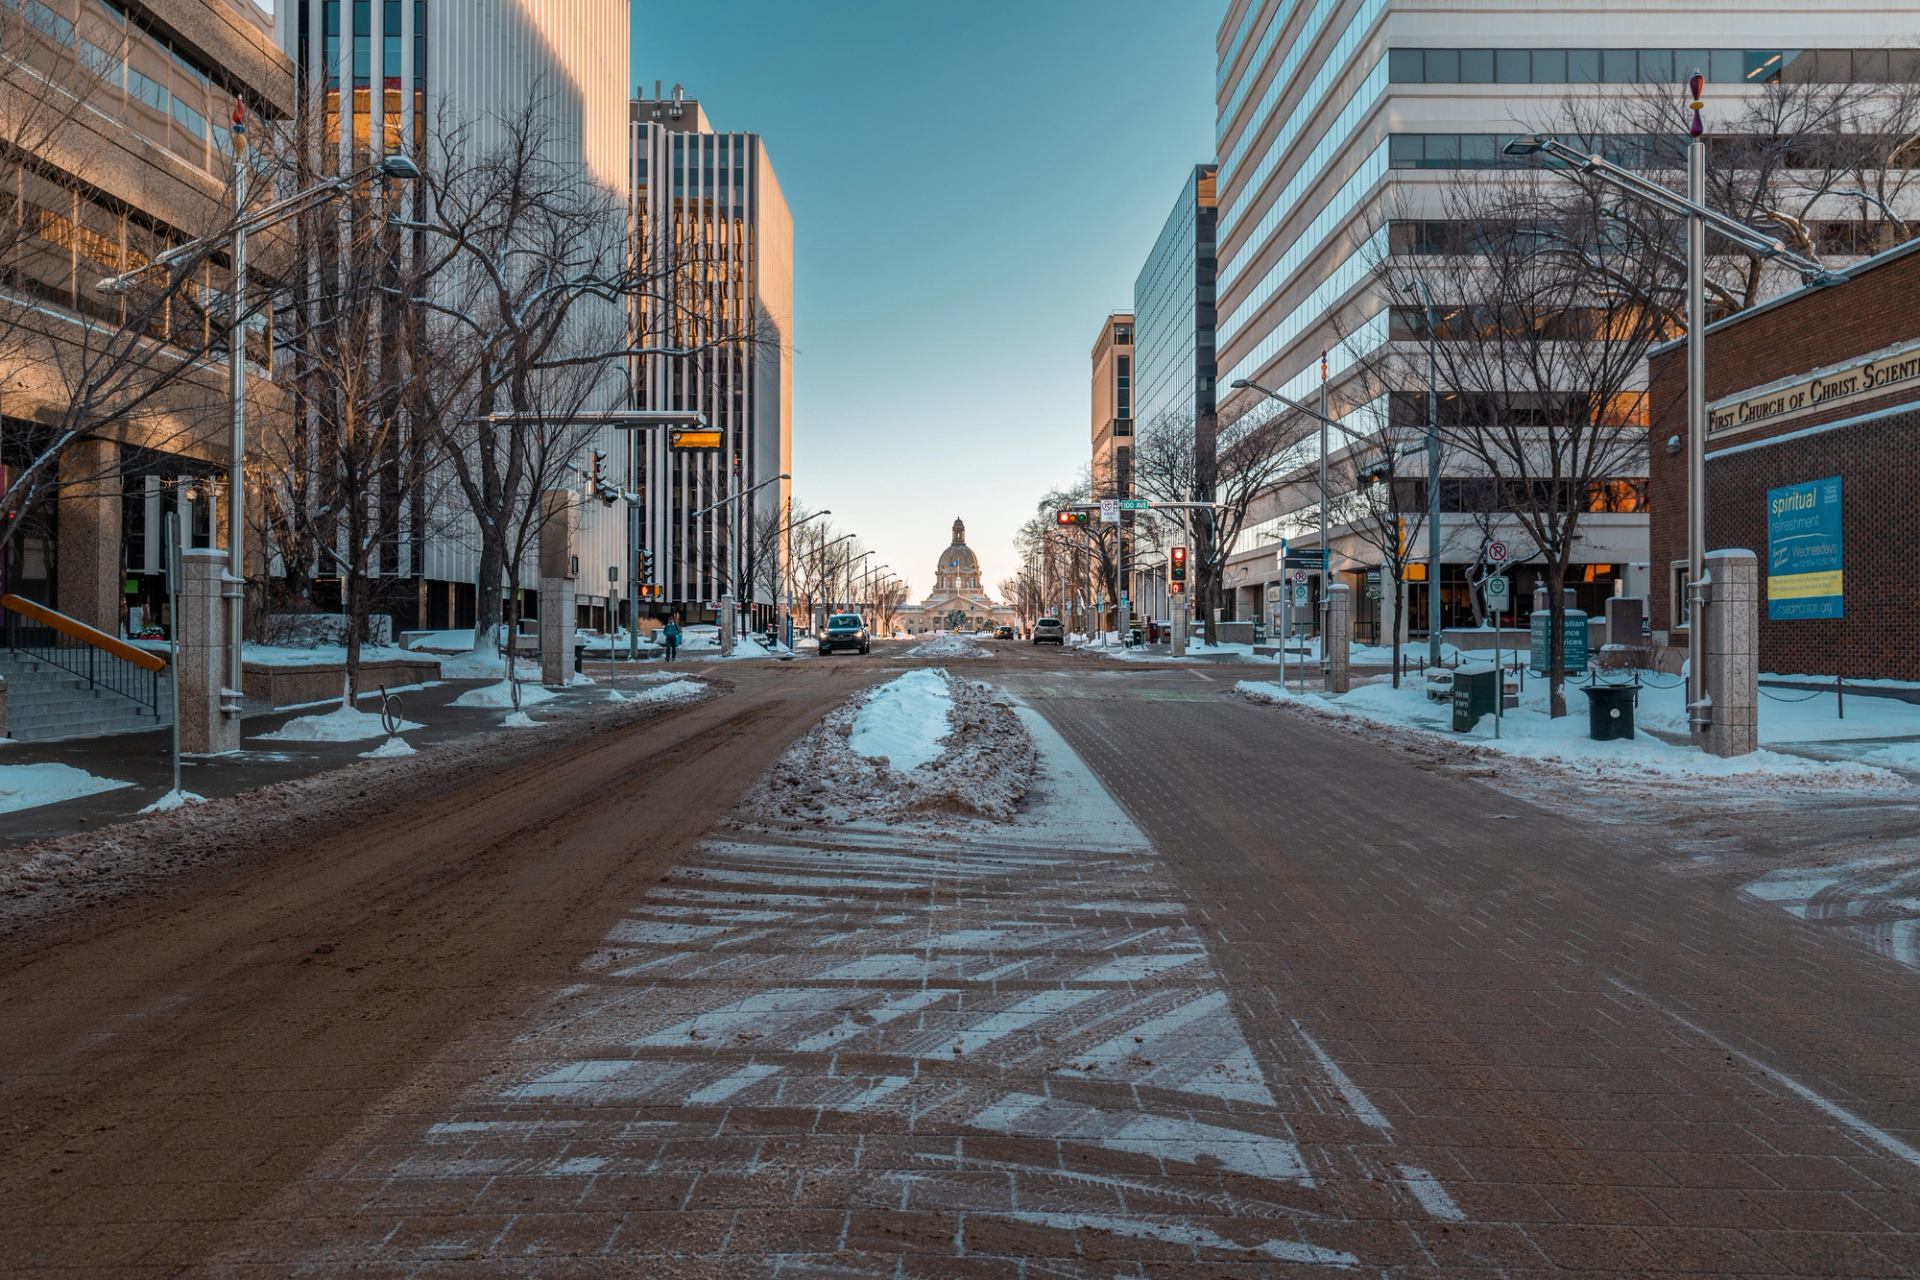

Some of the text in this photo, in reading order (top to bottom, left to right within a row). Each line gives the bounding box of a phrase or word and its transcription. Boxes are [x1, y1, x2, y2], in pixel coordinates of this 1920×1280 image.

[1708, 409, 1735, 432] FIRST
[1738, 401, 1785, 423] CHURCH
[1789, 391, 1805, 408] OF
[1123, 501, 1135, 509] 100
[1136, 500, 1147, 509] AVE
[1772, 487, 1817, 518] spiritual
[1771, 515, 1819, 533] refreshment
[1791, 543, 1838, 558] Wednesdays
